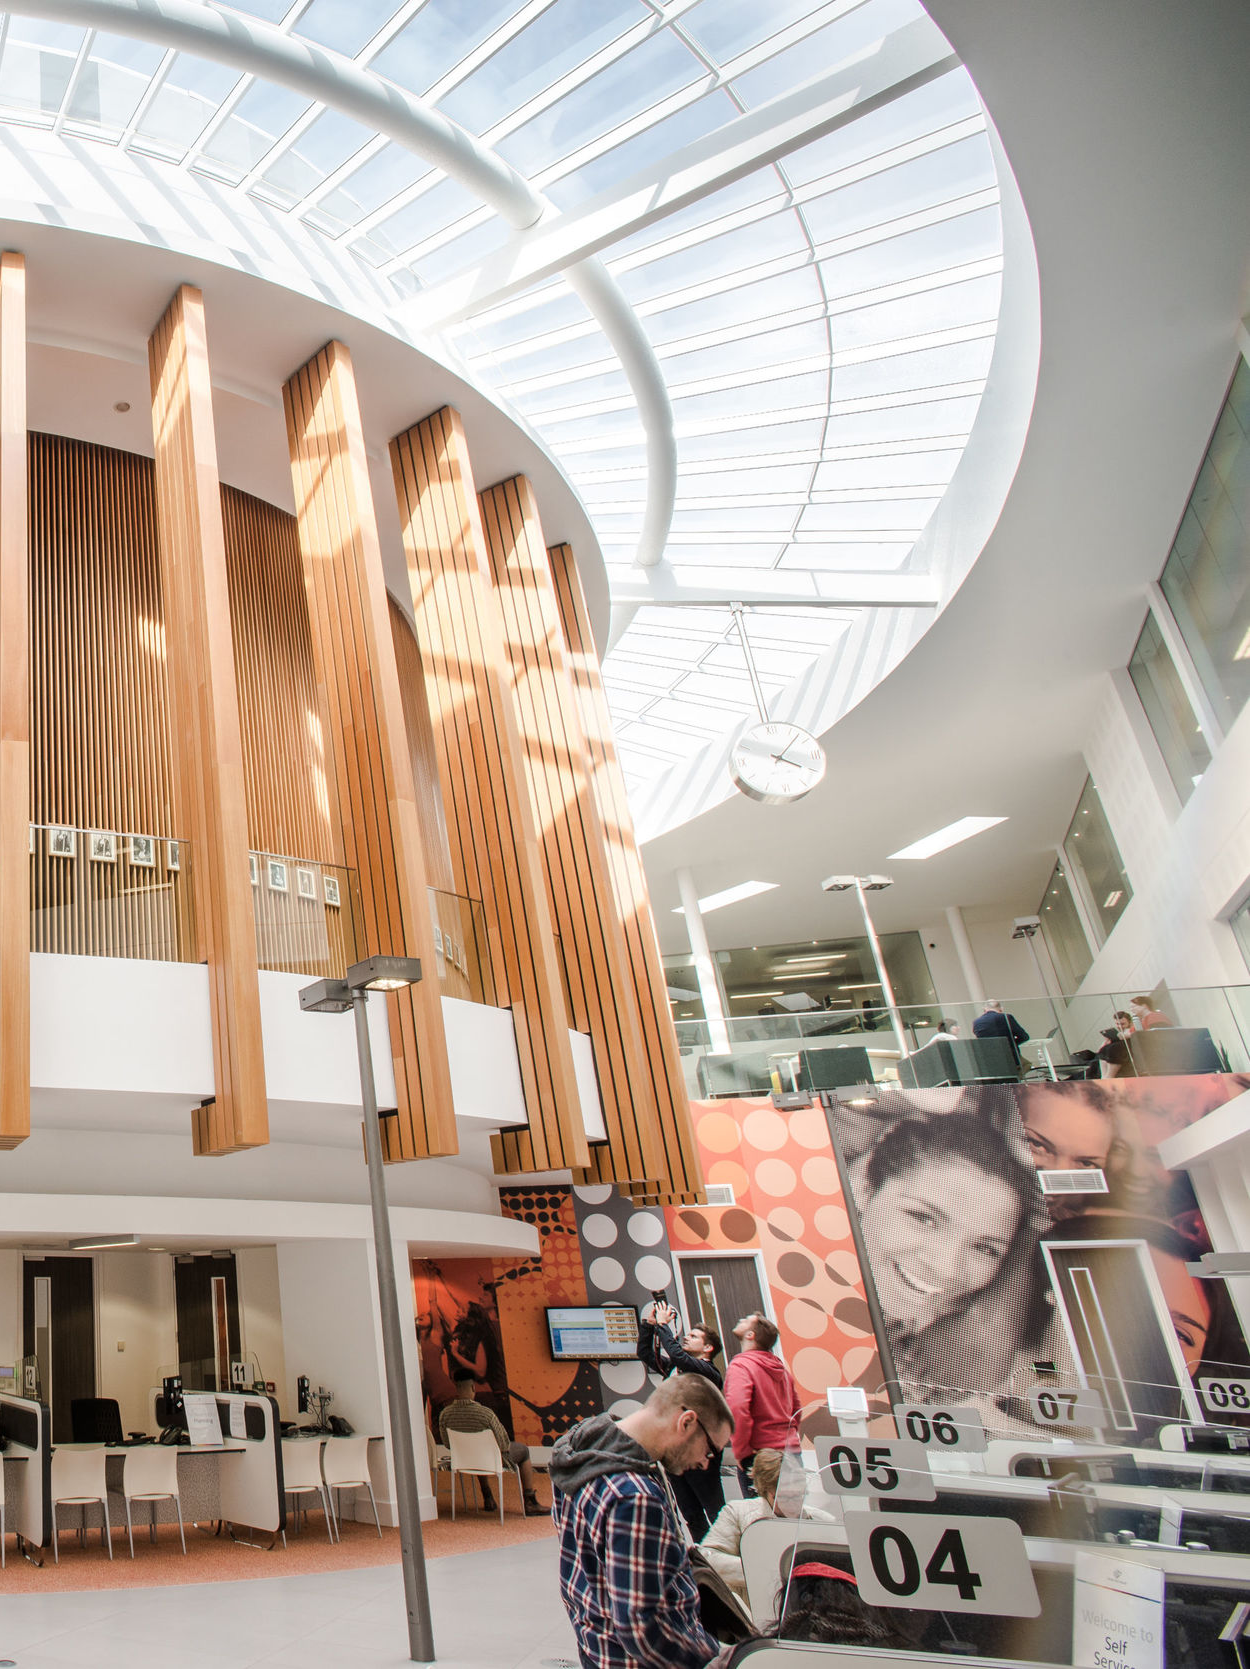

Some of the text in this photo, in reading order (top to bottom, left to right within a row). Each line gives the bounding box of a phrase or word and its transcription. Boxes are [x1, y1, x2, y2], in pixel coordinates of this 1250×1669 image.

[234, 1365, 246, 1381] 11
[1038, 1392, 1078, 1420] 07
[1209, 1382, 1250, 1409] 08
[906, 1411, 959, 1445] 06
[829, 1445, 899, 1491] 05
[868, 1525, 983, 1600] 04
[1082, 1609, 1154, 1644] Welcome to
[1094, 1651, 1136, 1669] Servi
[1105, 1636, 1128, 1656] Self
